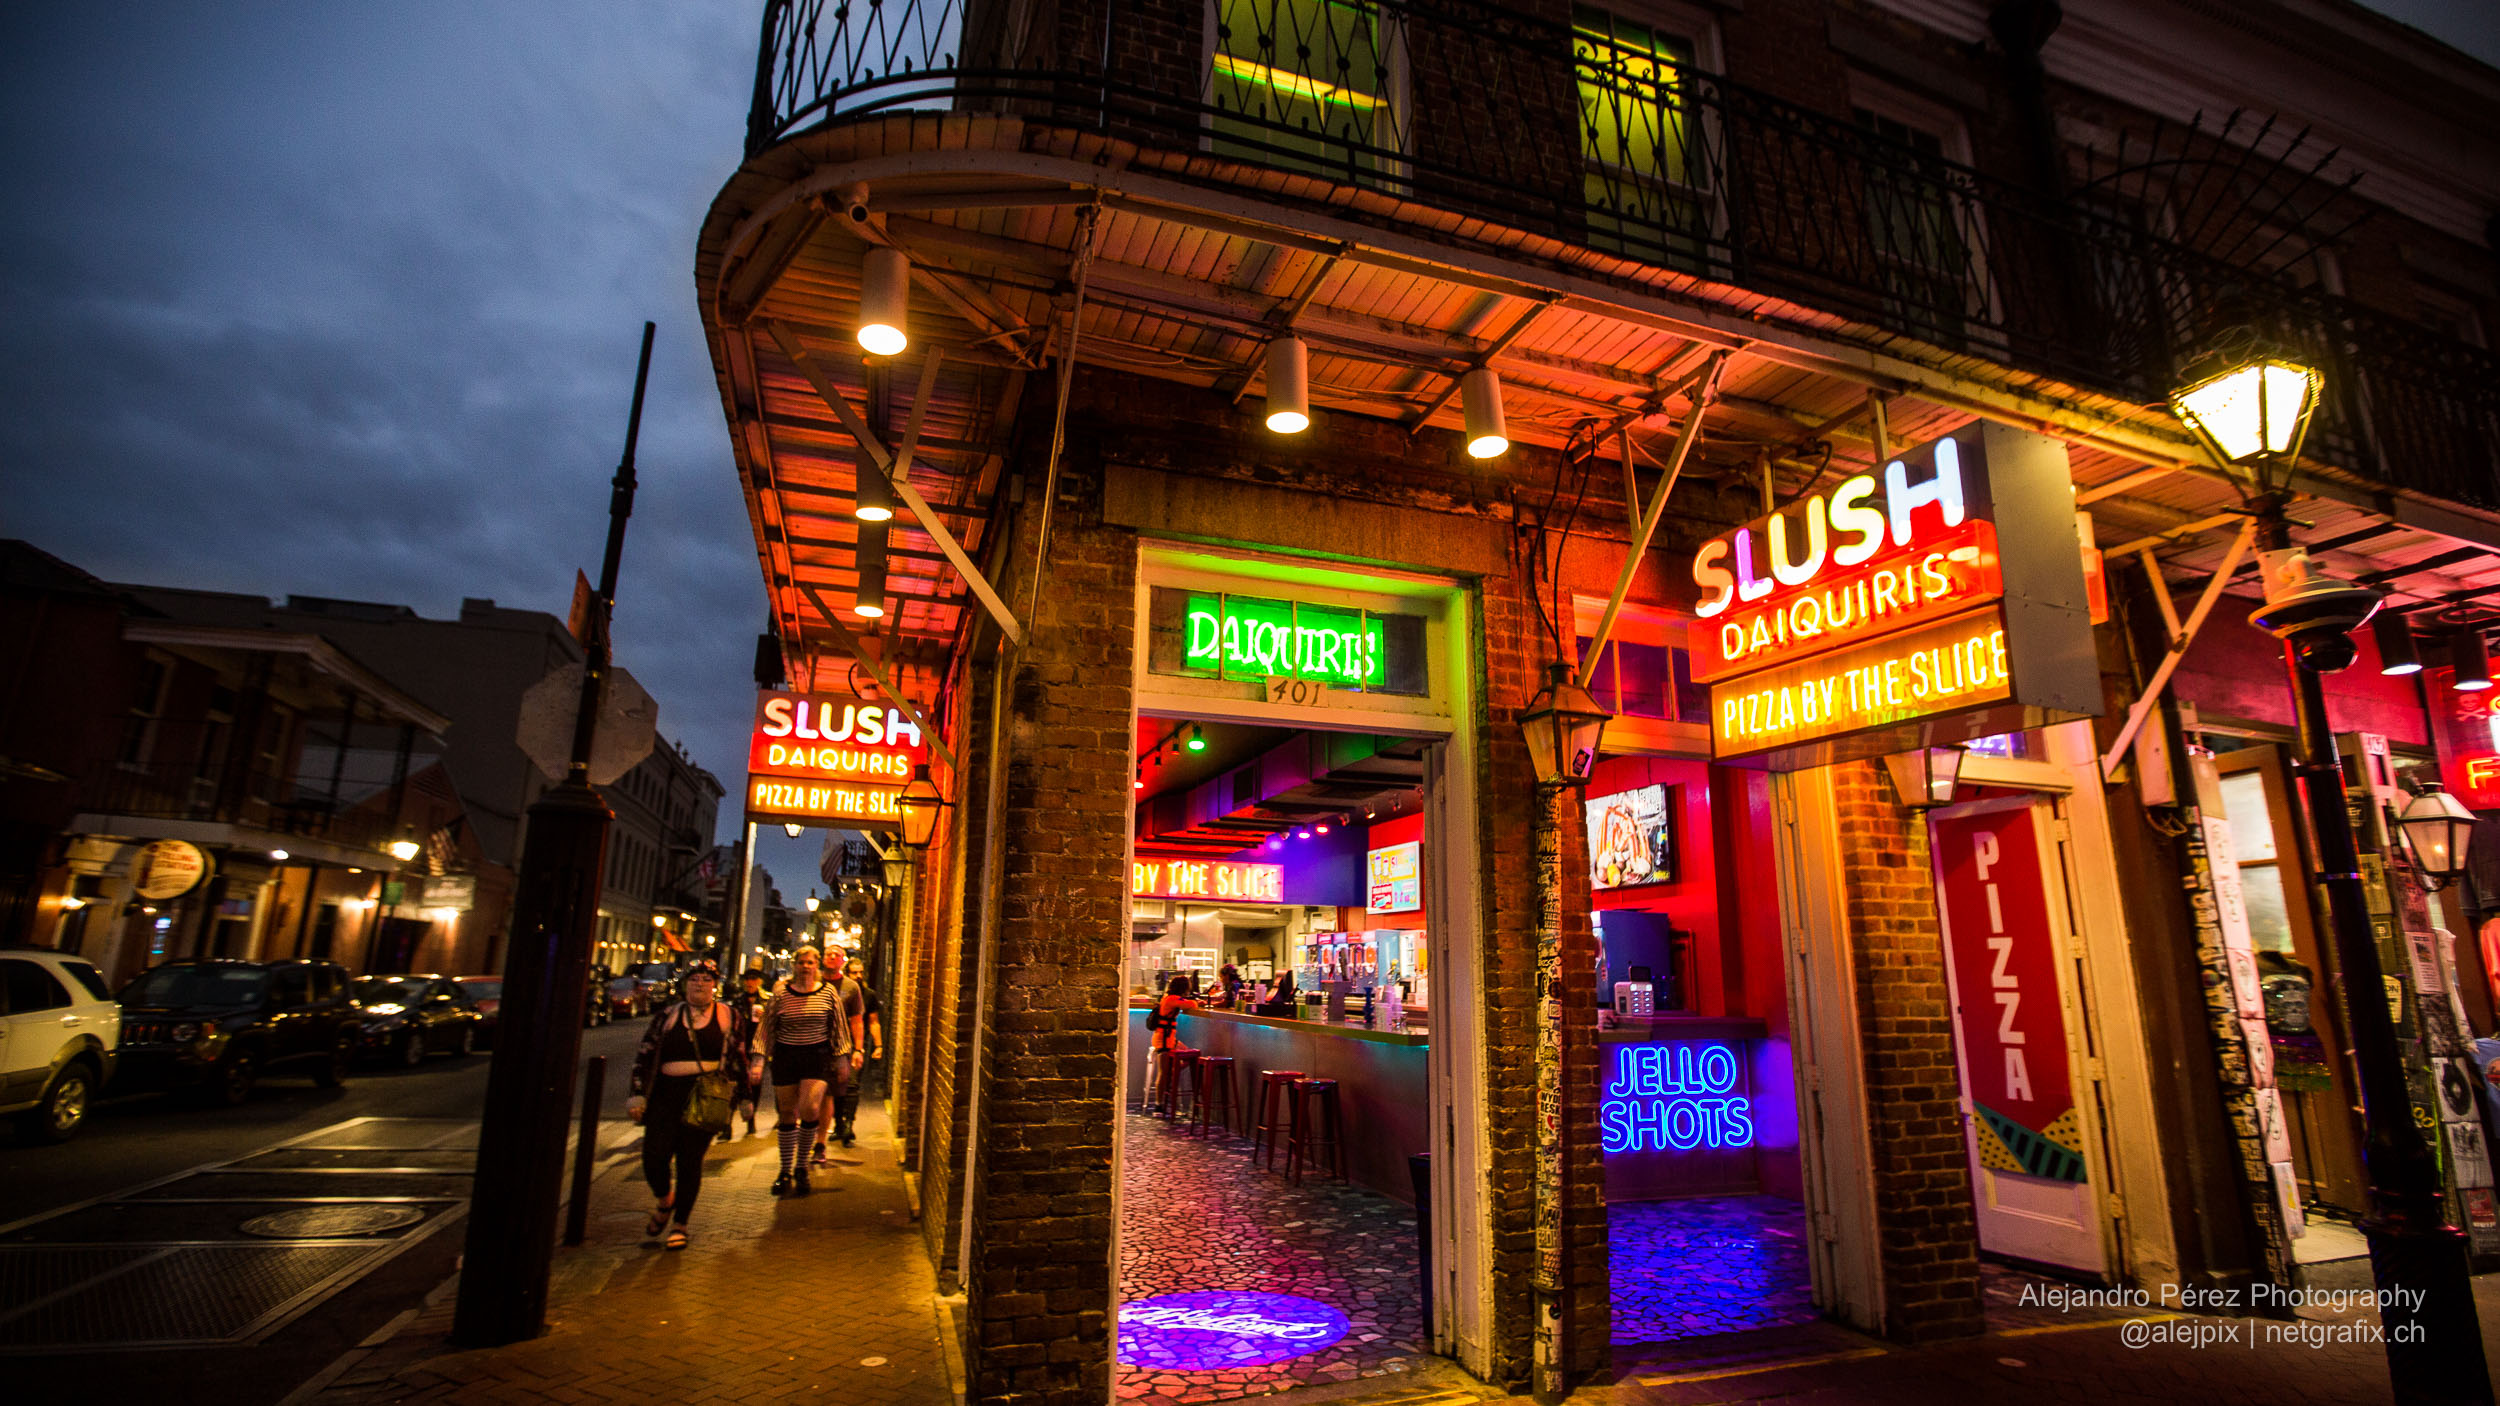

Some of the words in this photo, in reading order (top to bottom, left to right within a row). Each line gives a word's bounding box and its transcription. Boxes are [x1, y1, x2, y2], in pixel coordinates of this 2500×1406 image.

[1693, 437, 1965, 618] SLUSH
[1722, 553, 1949, 660] DAIQUIRIS
[1188, 611, 1375, 680] DAIQUIRIS
[1272, 680, 1320, 706] 401
[1724, 687, 1795, 738] PIZZA
[1801, 676, 1836, 723] BY
[1846, 660, 1902, 712] THE
[1910, 630, 2009, 697] SLICE
[763, 697, 922, 746] SLUSH
[768, 744, 909, 776] DAIQUIRIS
[756, 783, 804, 808] PIZZA
[809, 787, 831, 810] BY
[835, 790, 865, 813] THE
[1132, 862, 1160, 894] BY
[1168, 861, 1209, 894] THE
[1216, 865, 1279, 898] SLICE
[1972, 831, 2034, 1103] PIZZA
[1610, 1045, 1737, 1097] JELLO
[1600, 1097, 1753, 1152] SHOTS
